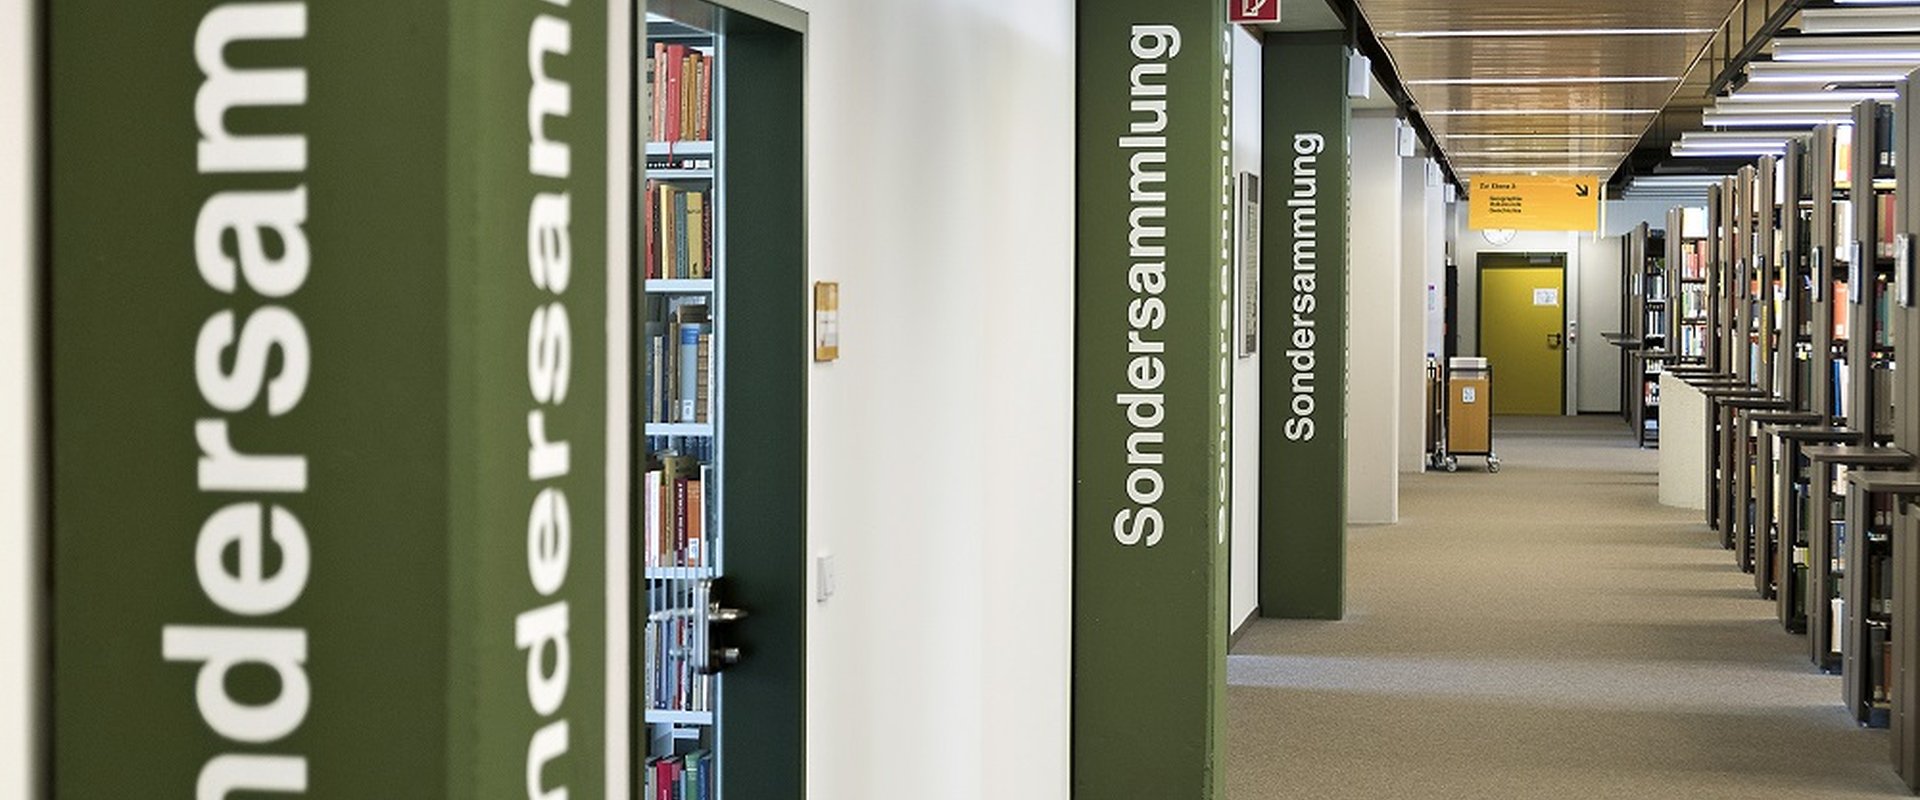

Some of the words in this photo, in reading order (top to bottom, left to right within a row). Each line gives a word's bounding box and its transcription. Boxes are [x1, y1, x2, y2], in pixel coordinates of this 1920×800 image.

[515, 0, 572, 800] ndersam
[1113, 23, 1182, 547] Sondersammlung
[1284, 132, 1325, 441] Sondersammlung
